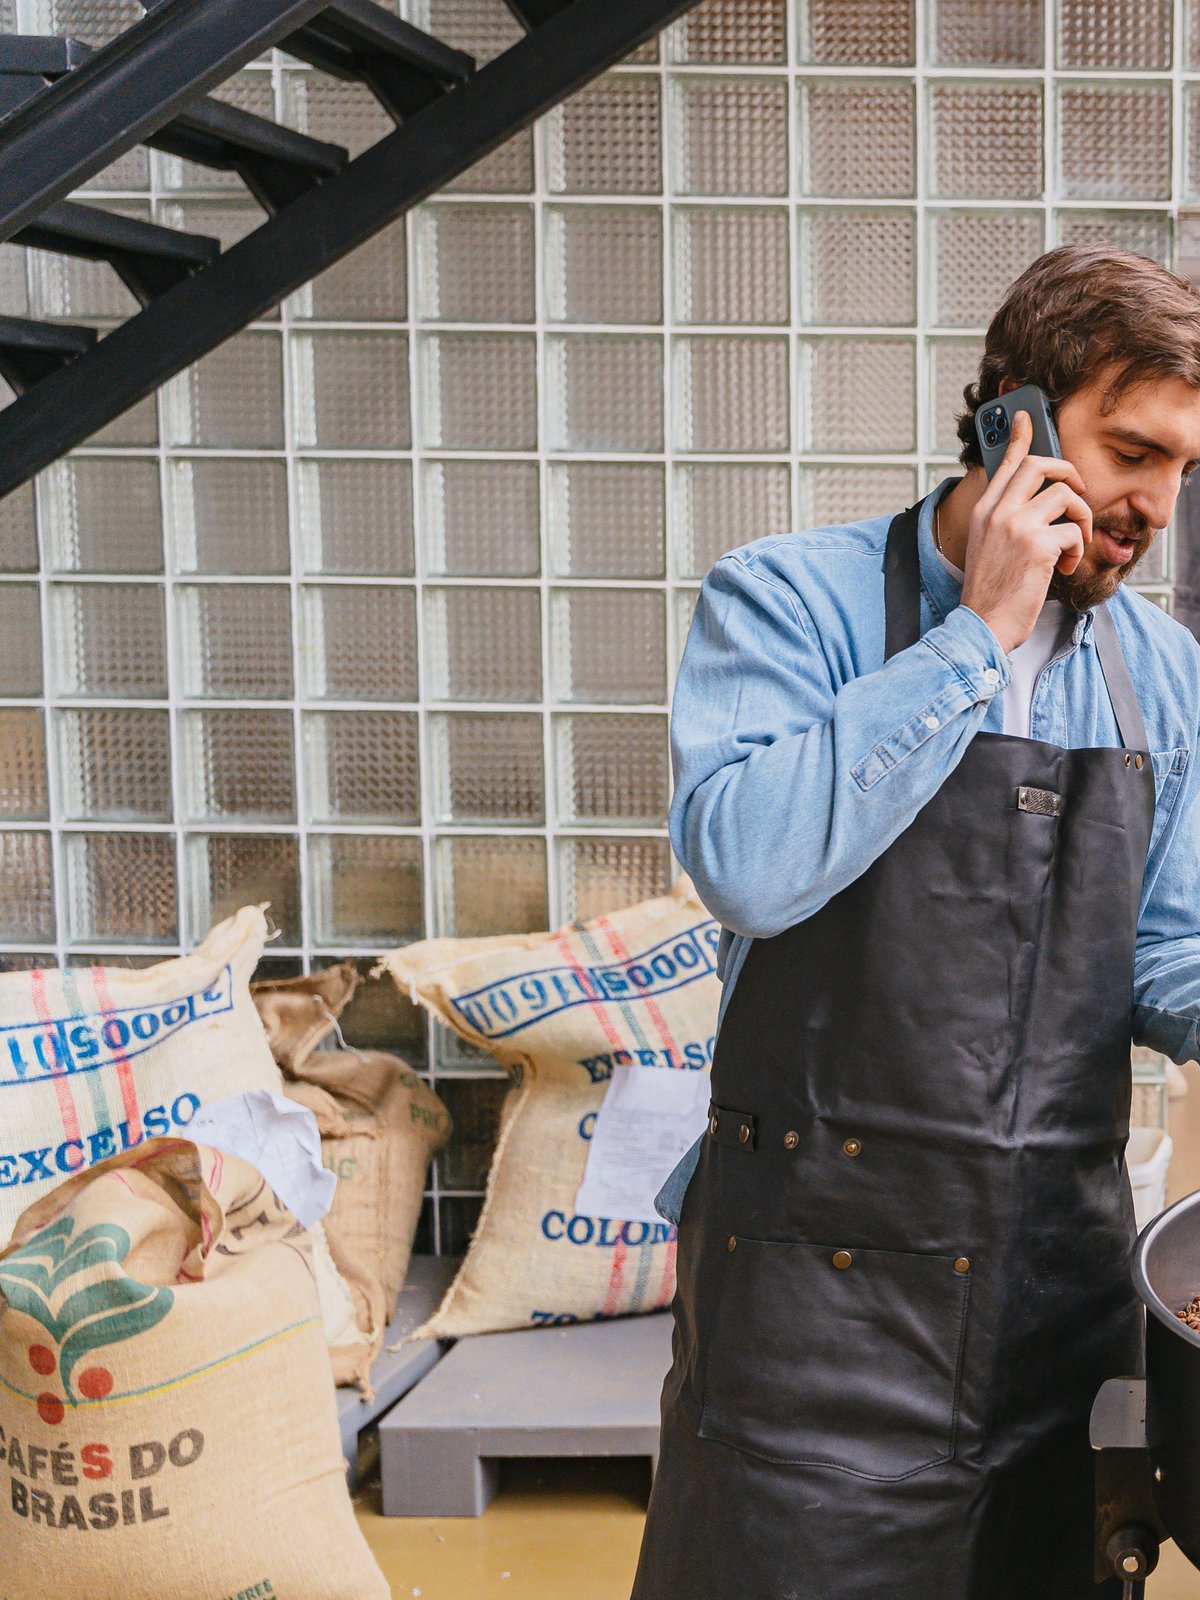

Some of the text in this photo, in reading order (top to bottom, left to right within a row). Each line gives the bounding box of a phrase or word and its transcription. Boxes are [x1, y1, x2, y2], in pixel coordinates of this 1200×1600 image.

[600, 942, 699, 992] 0005
[69, 1005, 186, 1059] 0005
[0, 1092, 201, 1188] EXCELSO
[129, 1427, 204, 1480] DO
[11, 1476, 170, 1530] BRASIL
